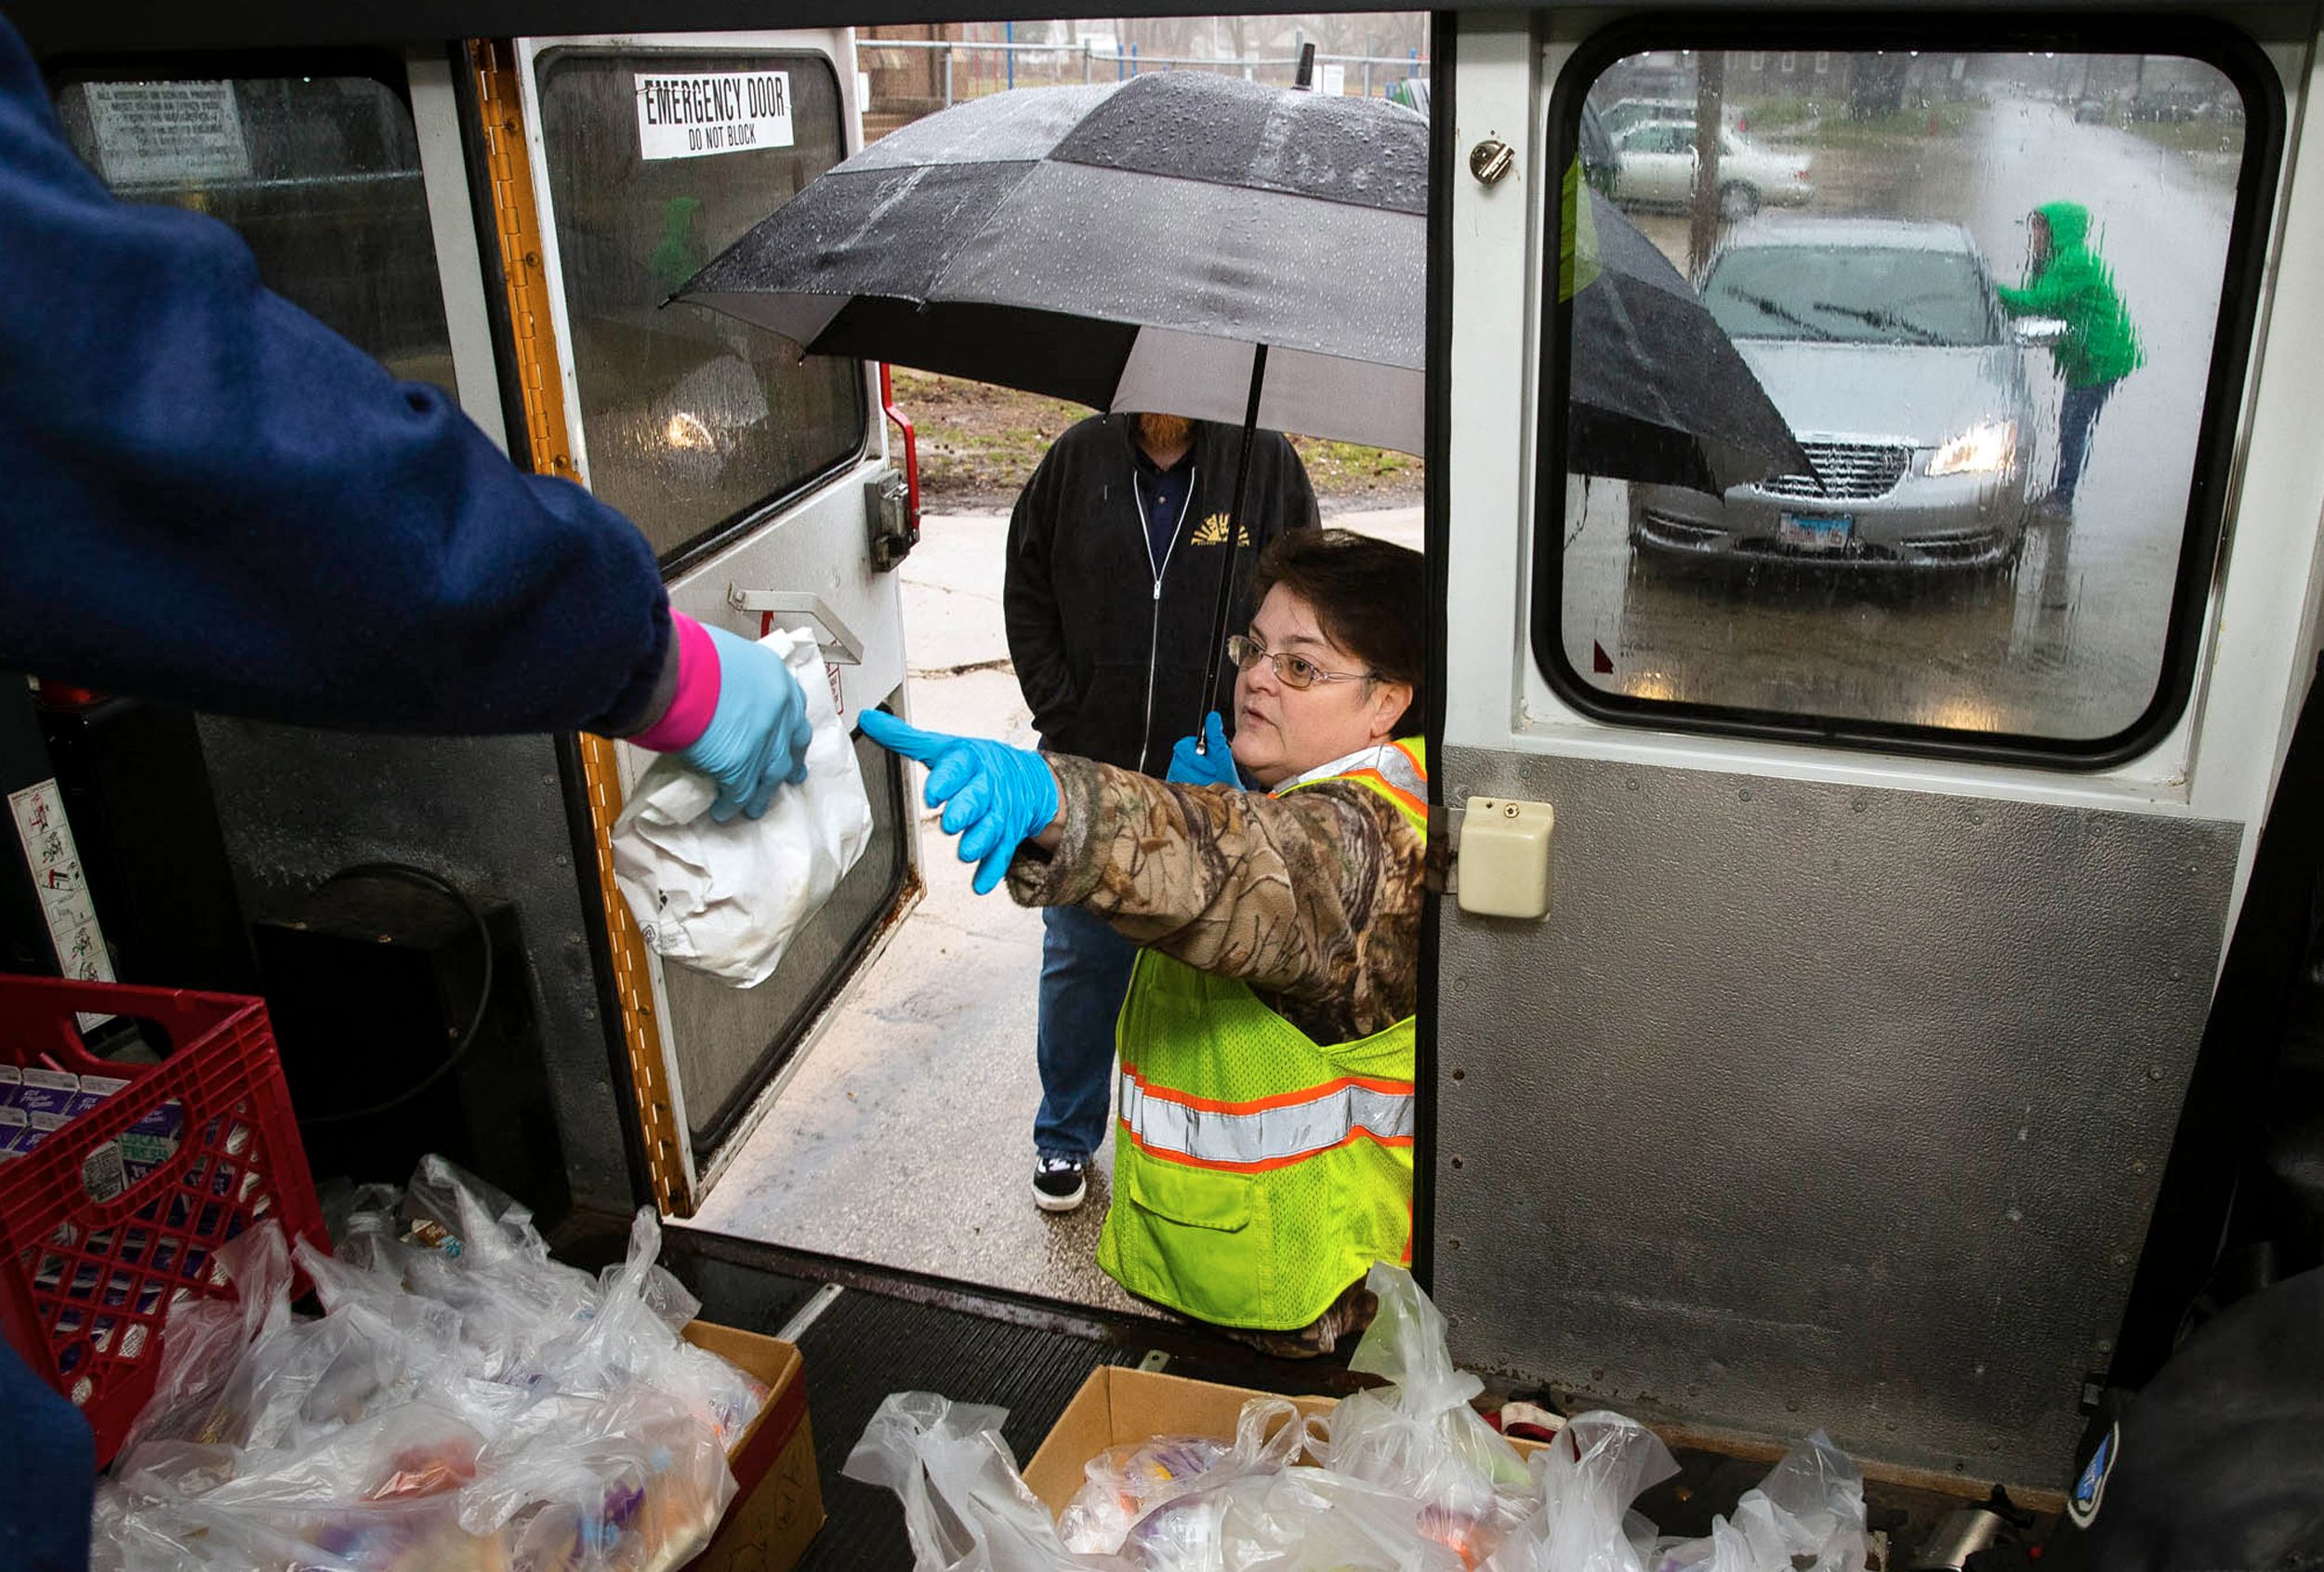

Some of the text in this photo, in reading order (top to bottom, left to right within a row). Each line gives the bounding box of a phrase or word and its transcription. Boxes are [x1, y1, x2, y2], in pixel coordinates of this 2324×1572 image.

[644, 76, 785, 125] EMERGENCY DOOR
[689, 124, 756, 151] DO NOT BLOCK
